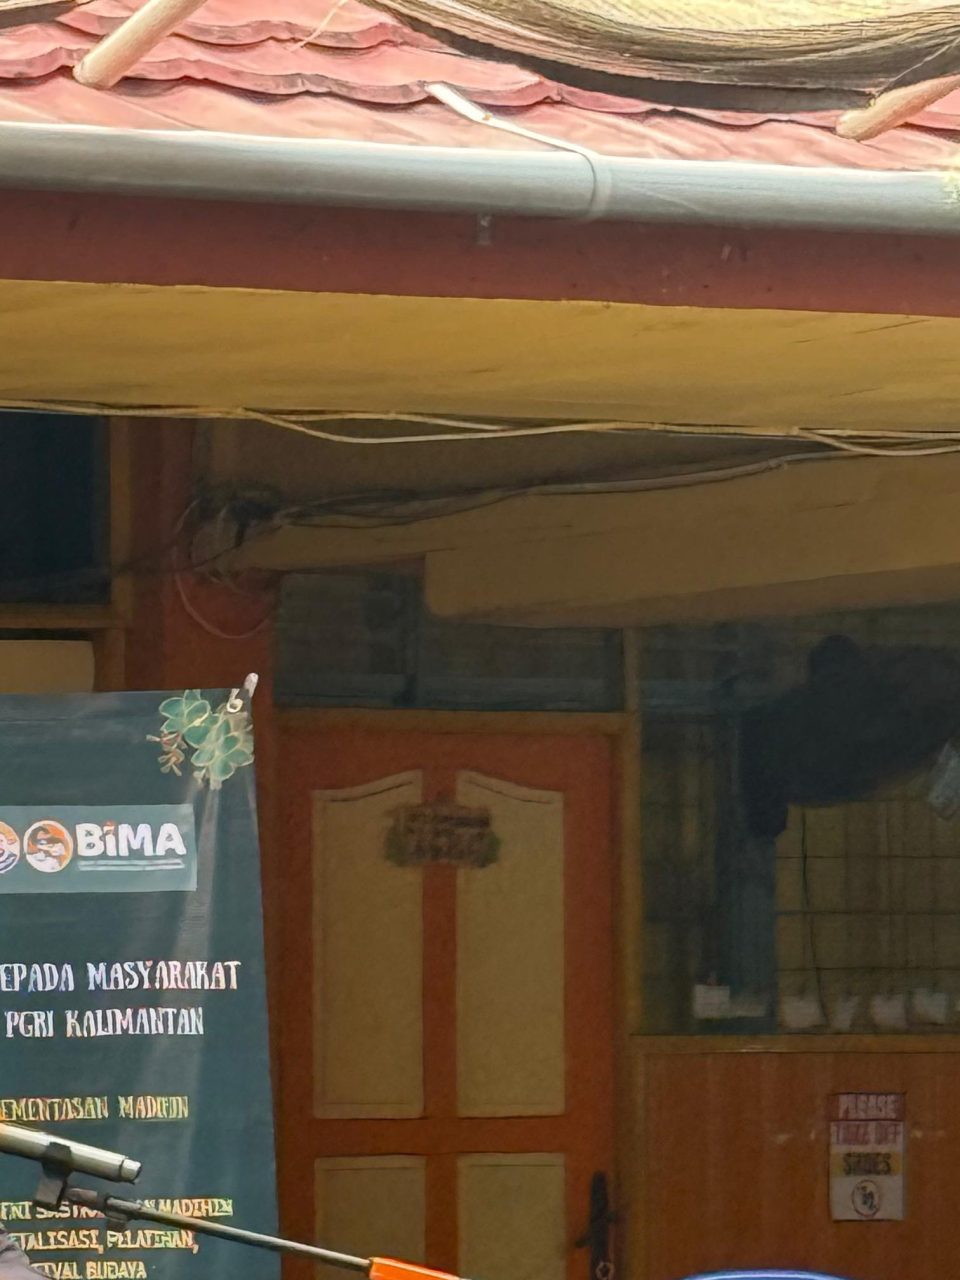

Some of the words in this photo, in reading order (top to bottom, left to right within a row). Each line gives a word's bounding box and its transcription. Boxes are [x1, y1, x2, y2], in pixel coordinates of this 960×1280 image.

[86, 959, 242, 990] MASYARAKAT
[4, 1009, 54, 1038] PGRI
[65, 1006, 205, 1037] KALIMANTAN
[86, 1261, 147, 1280] BUDAYA
